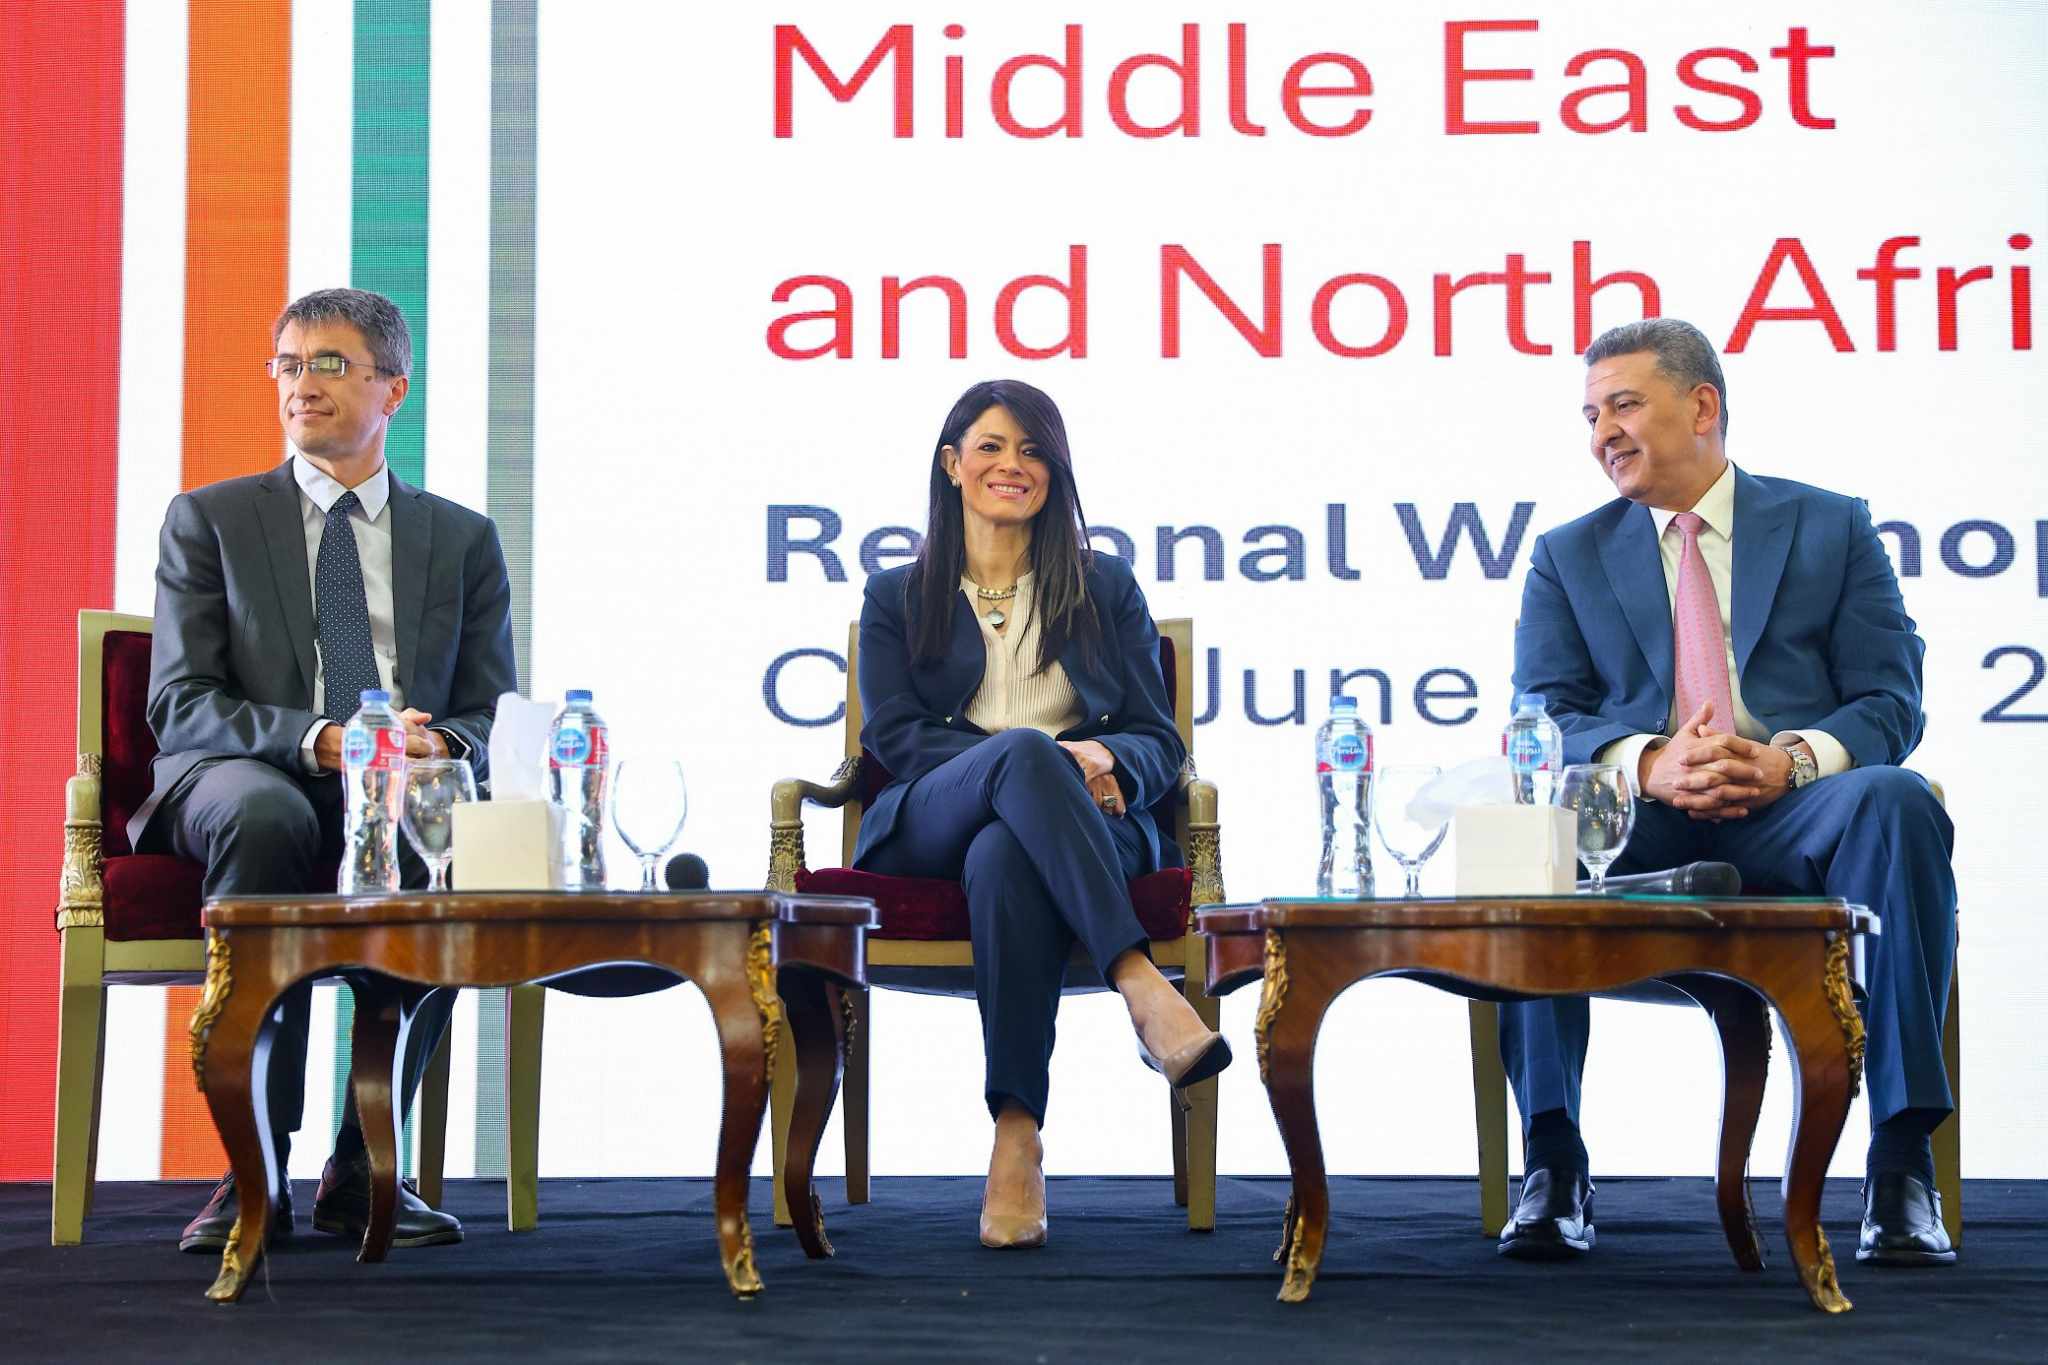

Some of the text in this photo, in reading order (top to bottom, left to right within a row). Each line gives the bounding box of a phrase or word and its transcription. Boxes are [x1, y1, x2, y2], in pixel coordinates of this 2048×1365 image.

[773, 19, 1836, 139] Middle East
[766, 244, 1088, 361] and
[1160, 240, 1662, 359] North
[1194, 647, 1479, 727] June
